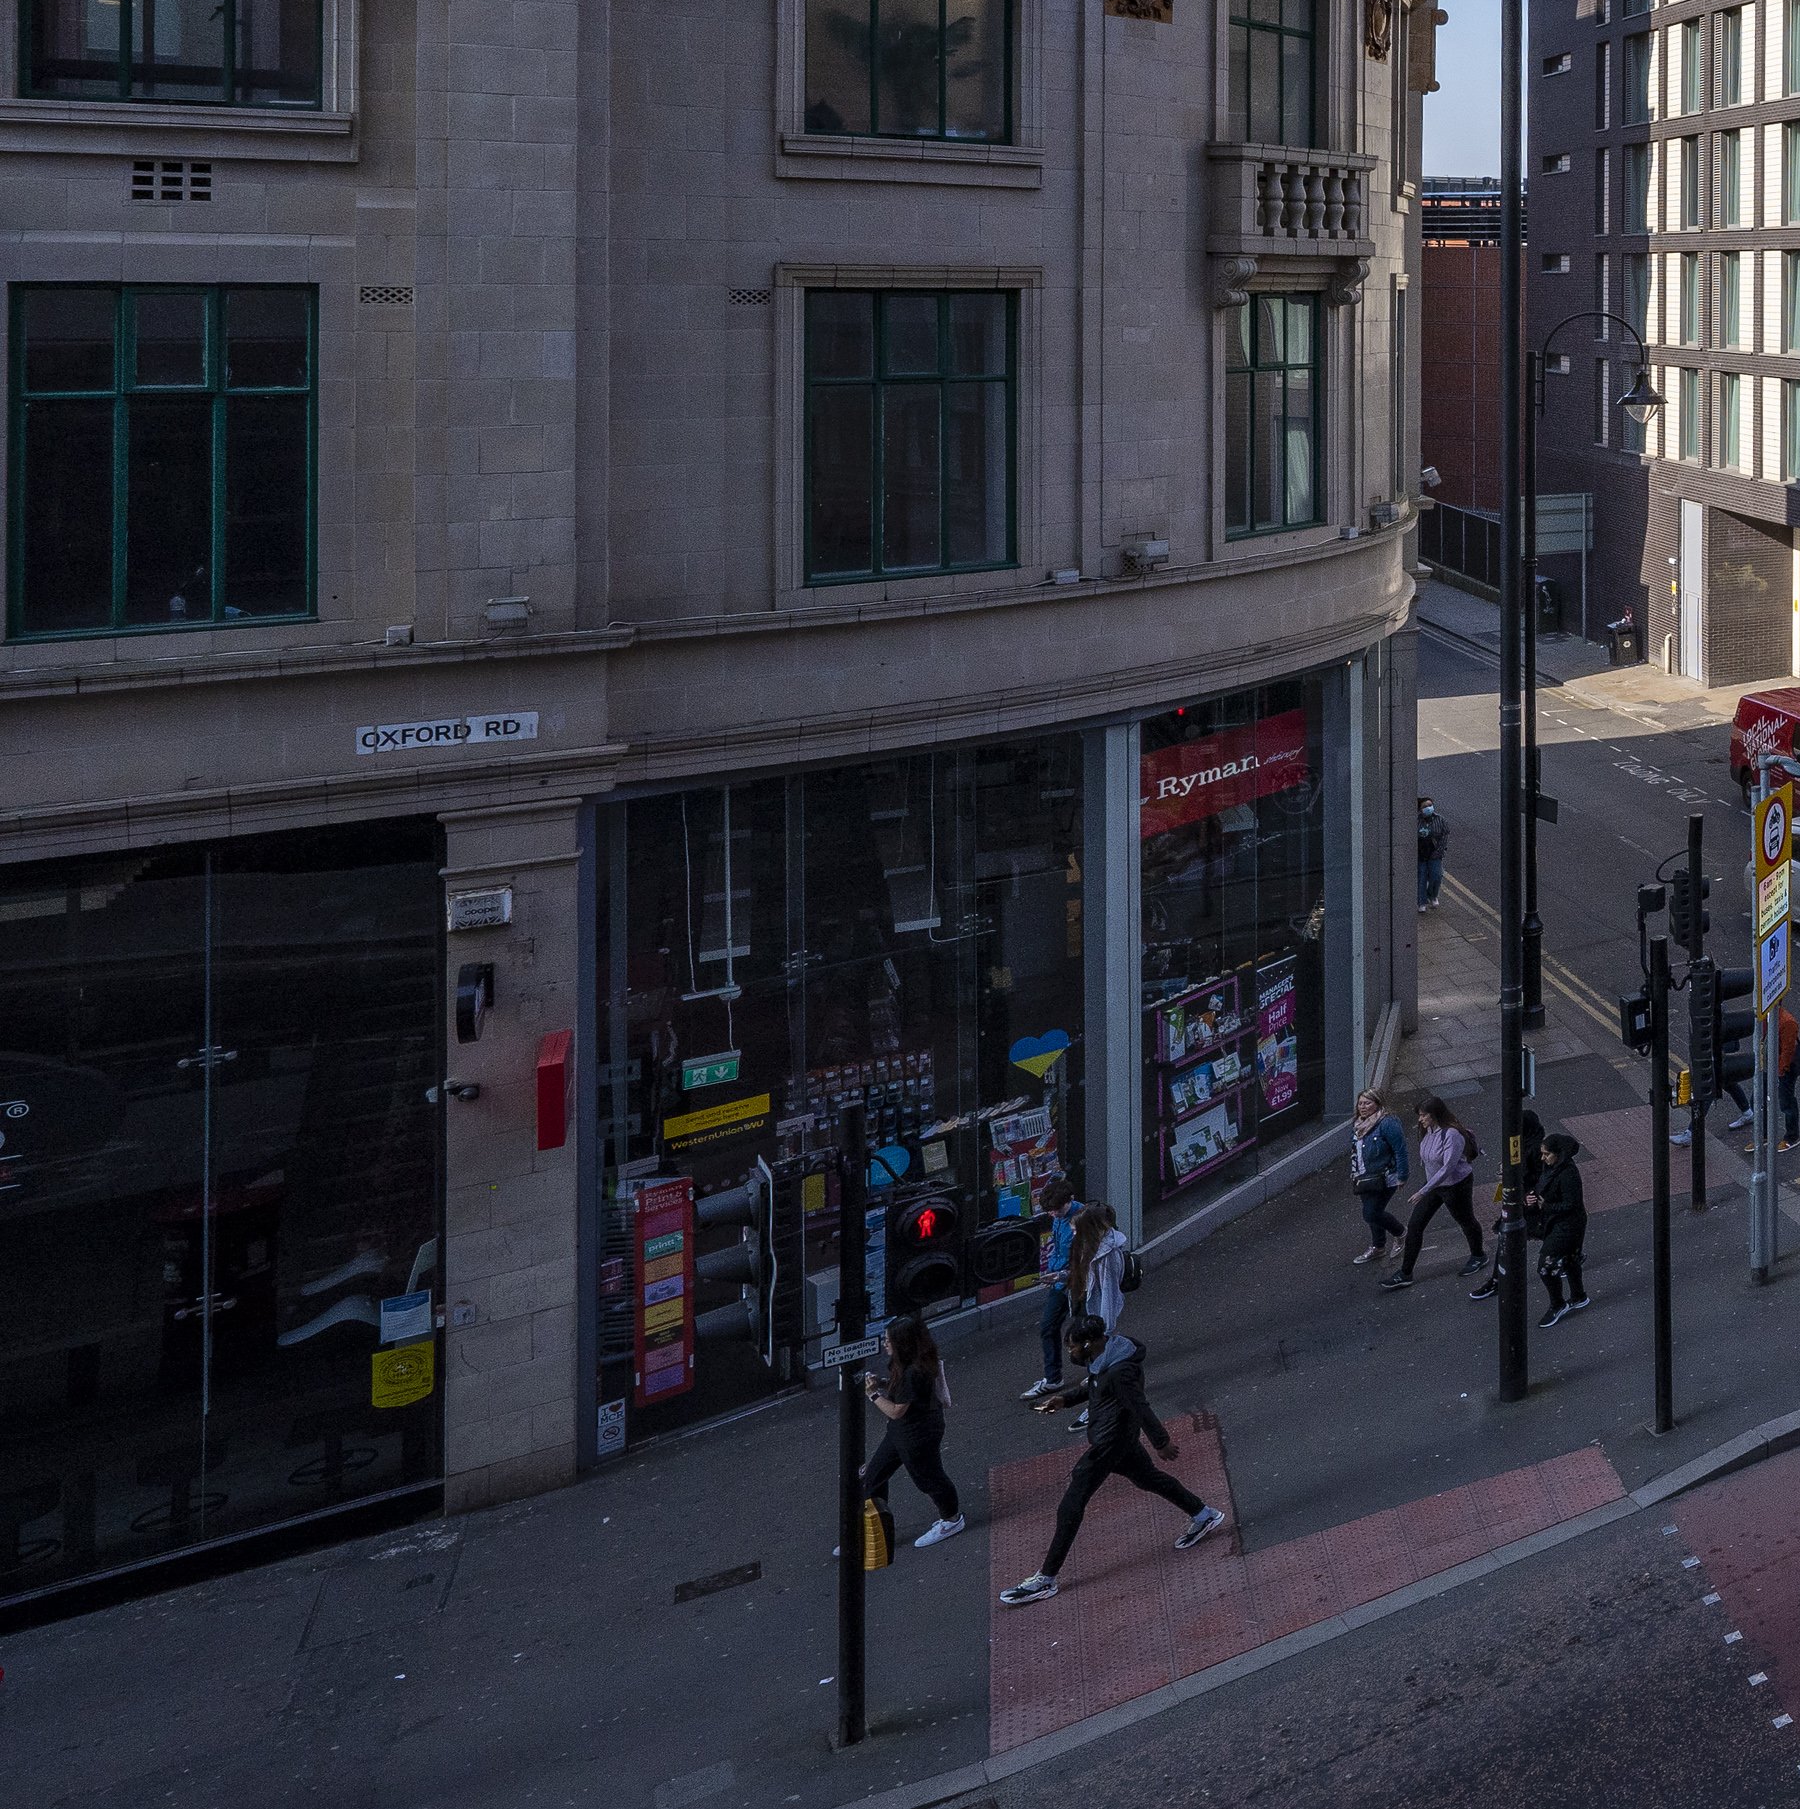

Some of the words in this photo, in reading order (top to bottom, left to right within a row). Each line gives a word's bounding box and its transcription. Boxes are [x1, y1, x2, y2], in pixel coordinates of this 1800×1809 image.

[362, 724, 471, 747] OXFORD
[486, 720, 520, 736] RD
[1157, 755, 1260, 800] Ryman
[1259, 974, 1294, 1001] MANAGER'S
[1268, 1003, 1287, 1023] Half
[1267, 1016, 1288, 1033] Price
[1274, 1083, 1289, 1095] Now
[1271, 1088, 1293, 1107] £1.99
[645, 1192, 672, 1206] Print
[645, 1199, 683, 1214] Services
[843, 1340, 876, 1352] loading
[839, 1353, 855, 1362] any
[857, 1347, 876, 1356] time
[601, 1411, 623, 1424] MCR
